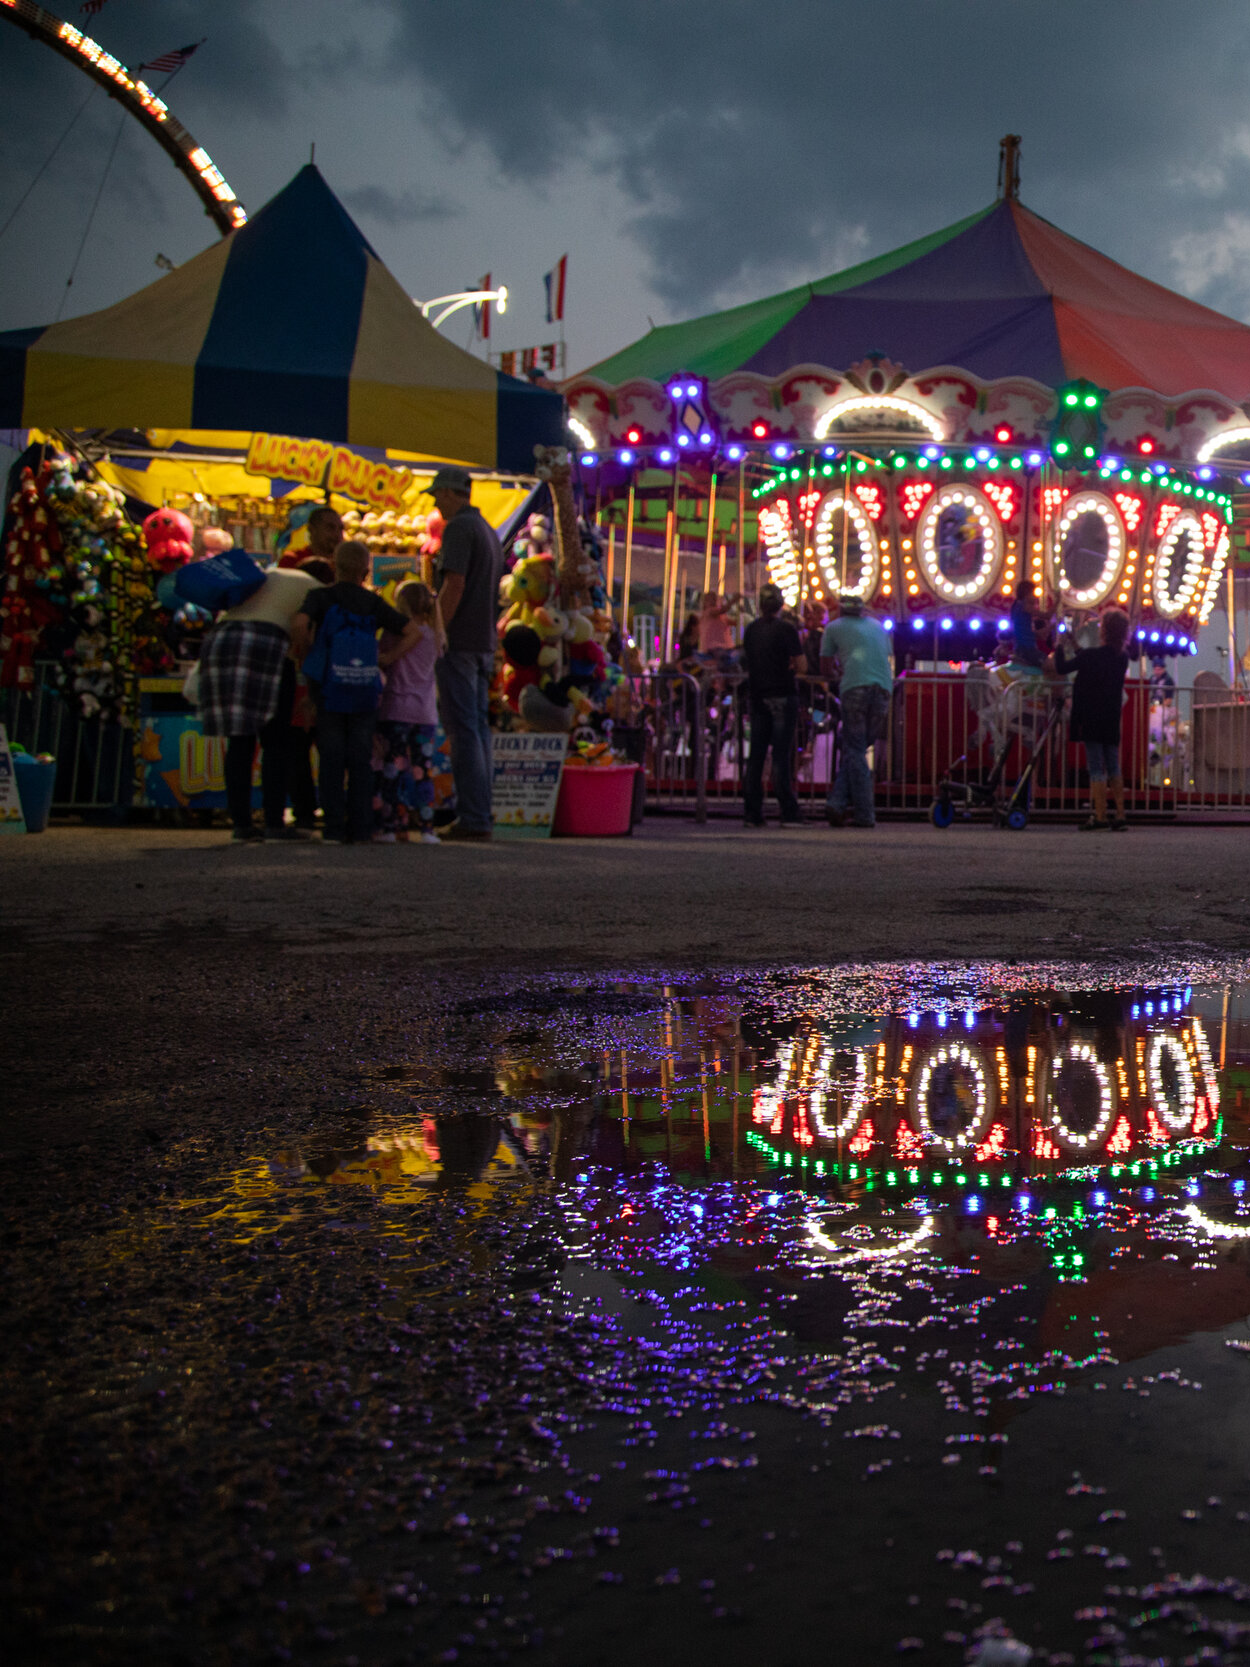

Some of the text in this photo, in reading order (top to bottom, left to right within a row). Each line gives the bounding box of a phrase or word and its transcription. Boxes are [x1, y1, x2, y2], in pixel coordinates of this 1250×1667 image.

[247, 433, 411, 511] LUCKY DUCK
[494, 738, 562, 750] LUCKY DUCK
